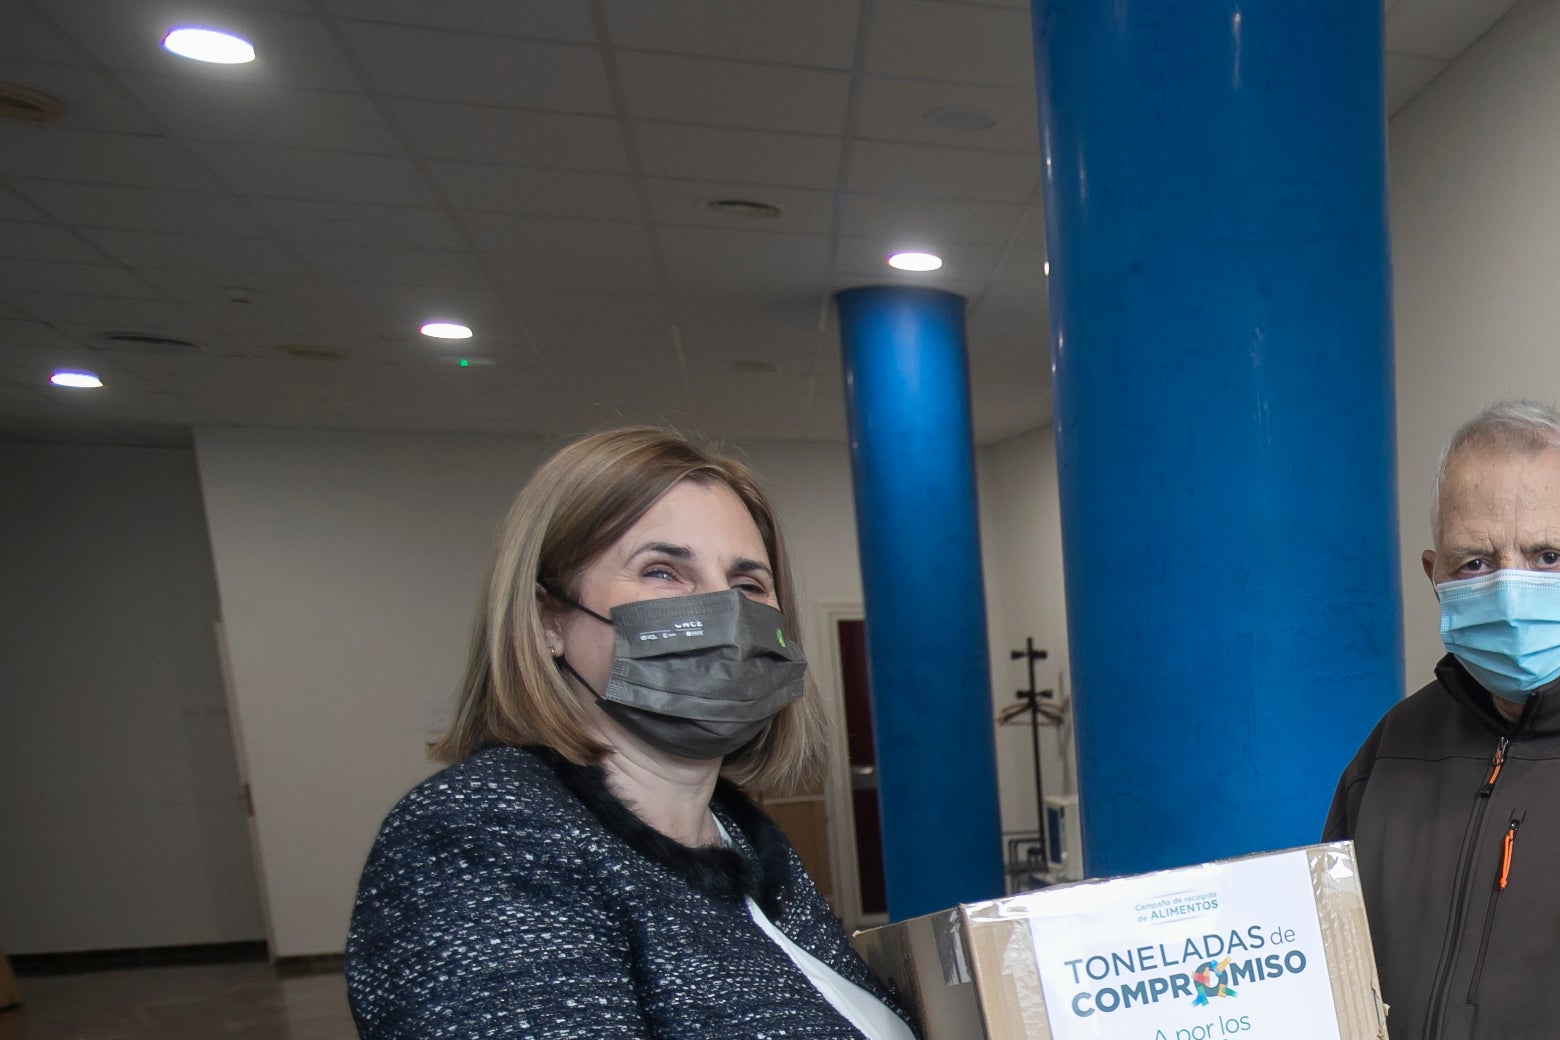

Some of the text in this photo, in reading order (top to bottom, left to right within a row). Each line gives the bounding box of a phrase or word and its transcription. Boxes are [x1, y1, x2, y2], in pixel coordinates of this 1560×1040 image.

[1151, 900, 1218, 919] ALIMENTOS
[1064, 925, 1295, 984] TONELADAS de
[1071, 950, 1306, 1017] COMPROMISO
[1219, 1016, 1251, 1035] los
